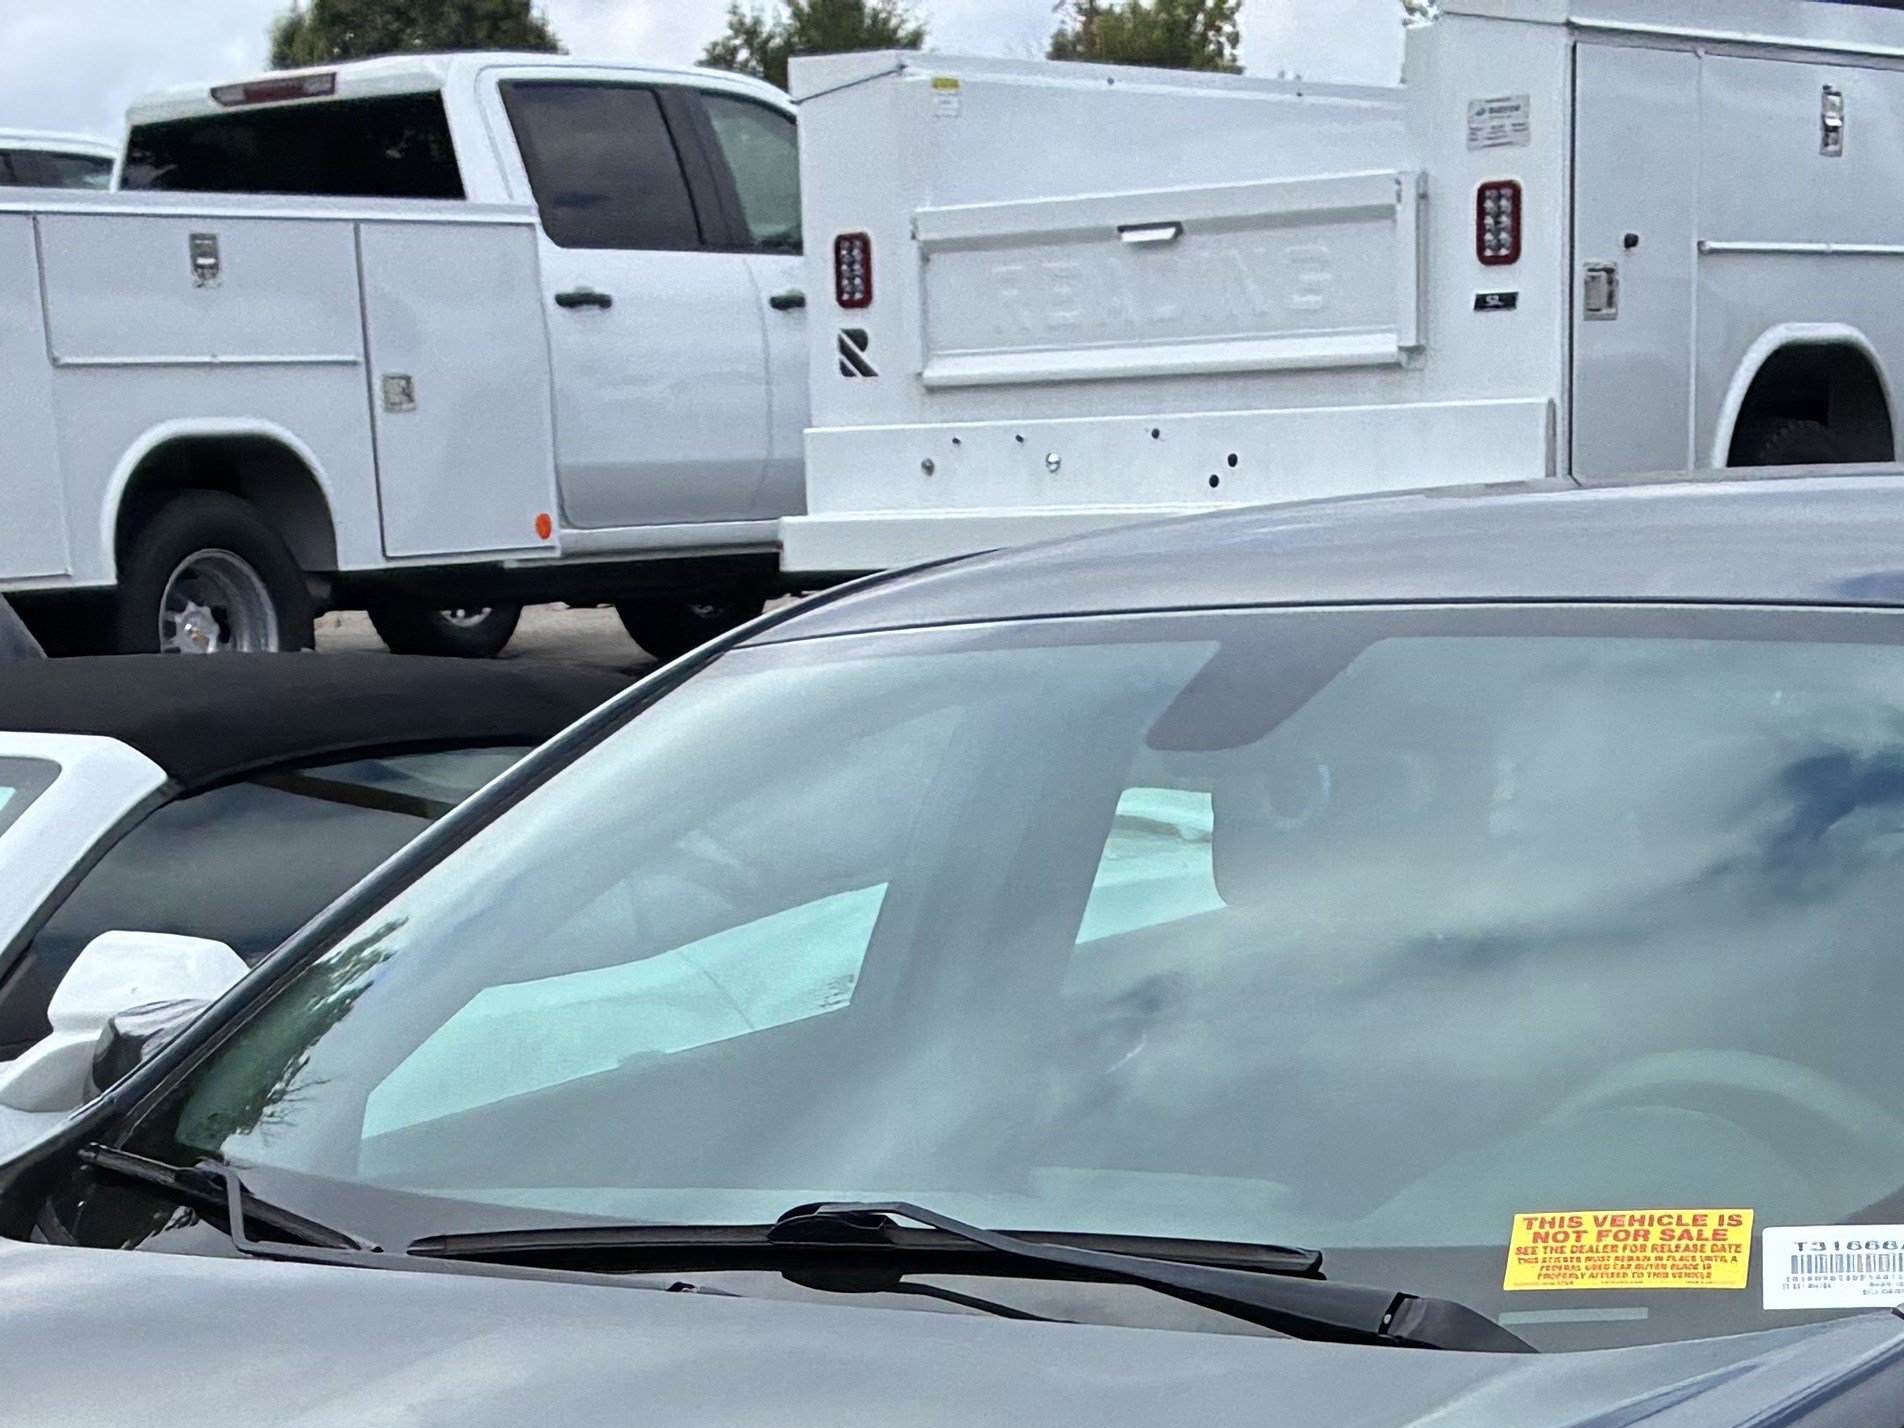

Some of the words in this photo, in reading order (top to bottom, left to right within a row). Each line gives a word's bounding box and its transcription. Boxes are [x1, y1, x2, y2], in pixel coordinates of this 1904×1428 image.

[1523, 1215, 1583, 1230] THIS
[1593, 1214, 1709, 1227] VEHICLE
[1717, 1214, 1743, 1227] IS
[1532, 1230, 1589, 1243] NOT
[1596, 1229, 1651, 1242] FOR
[1659, 1228, 1729, 1241] SALE
[1515, 1246, 1538, 1255] SEE
[1542, 1245, 1567, 1254] THE
[1570, 1244, 1619, 1254] DEALER
[1622, 1244, 1647, 1253] FOR
[1651, 1243, 1706, 1253] RELEASE
[1711, 1243, 1742, 1253] DATE
